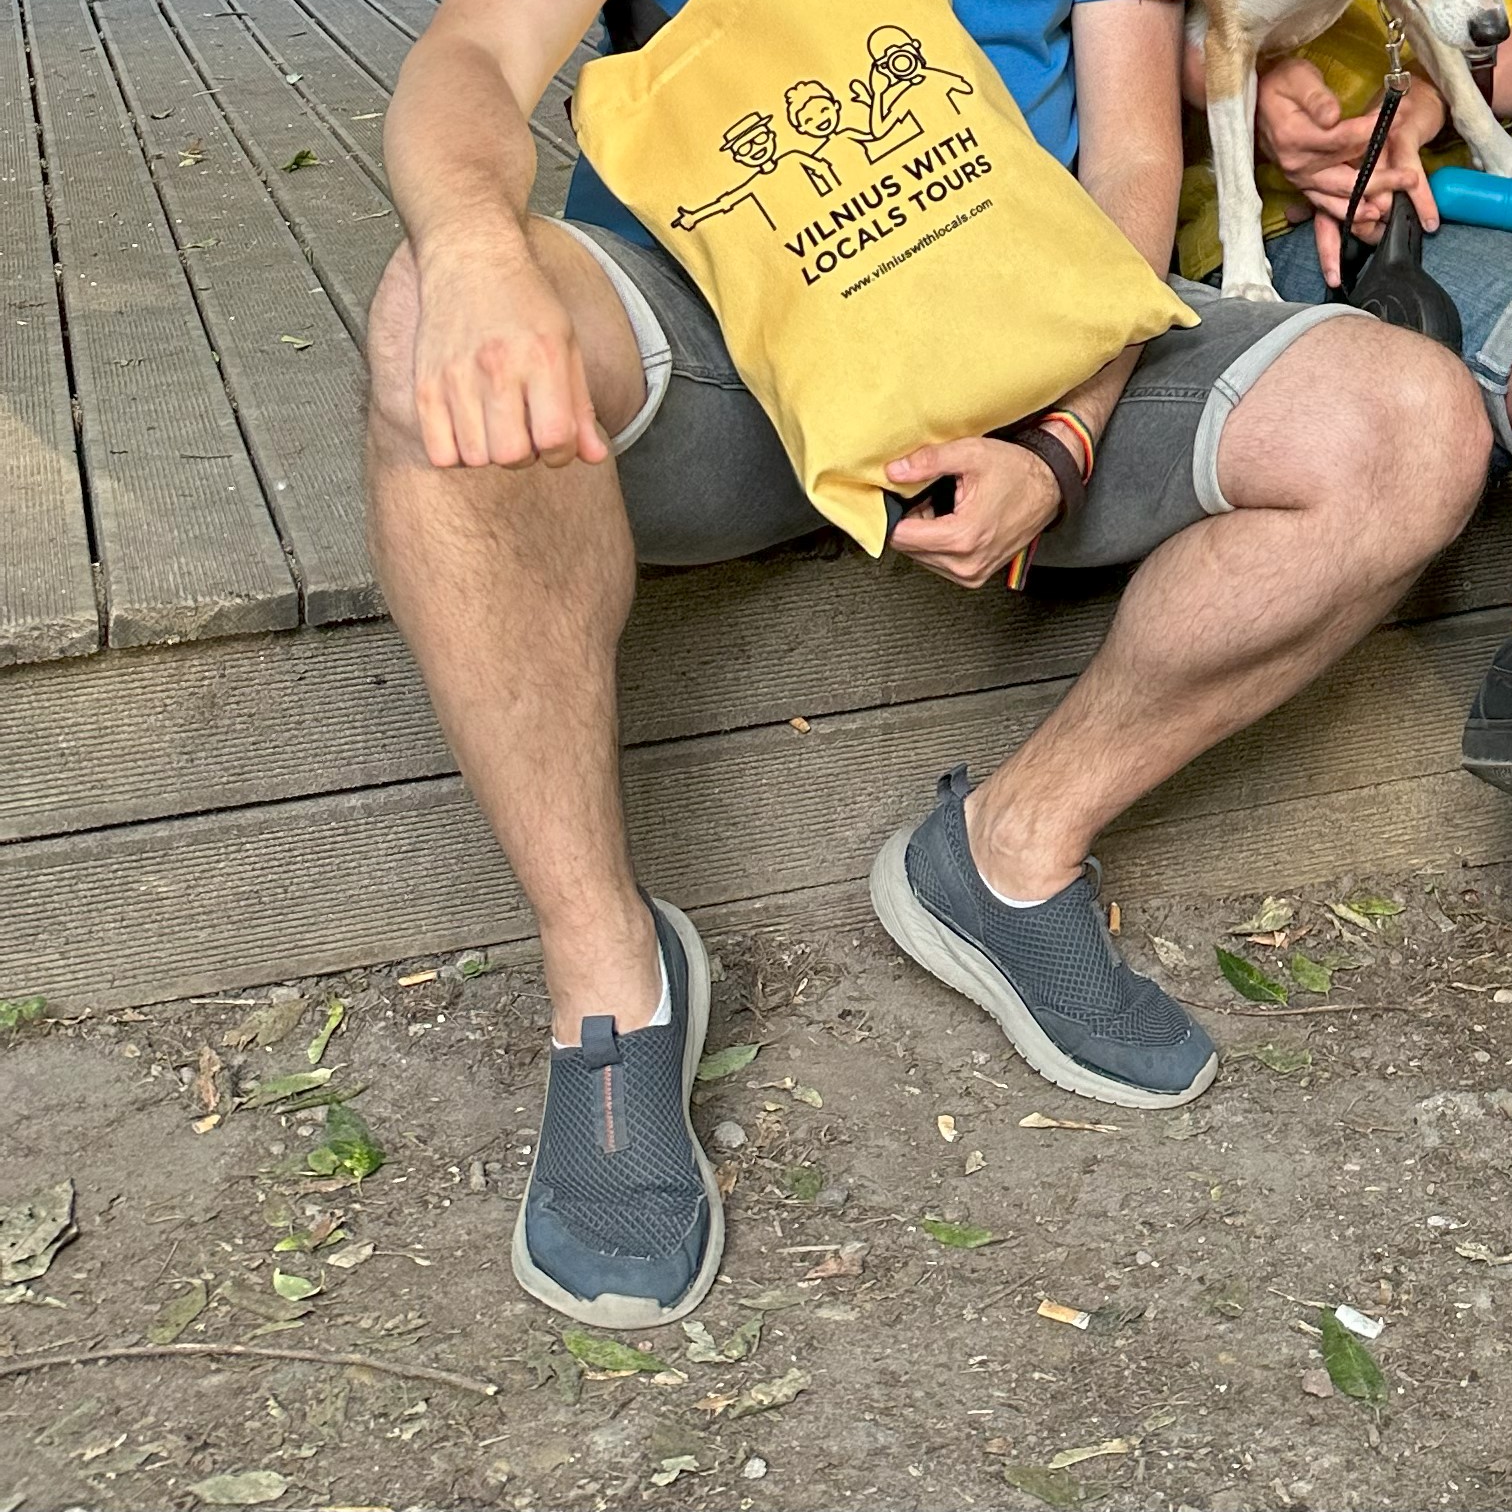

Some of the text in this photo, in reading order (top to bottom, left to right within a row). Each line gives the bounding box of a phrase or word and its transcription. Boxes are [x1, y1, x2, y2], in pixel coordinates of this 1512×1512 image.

[784, 127, 979, 258] VILNIUS WITH
[801, 154, 993, 286] LOCALS TOURS
[840, 198, 994, 299] www.vilniuswithlocals.com
